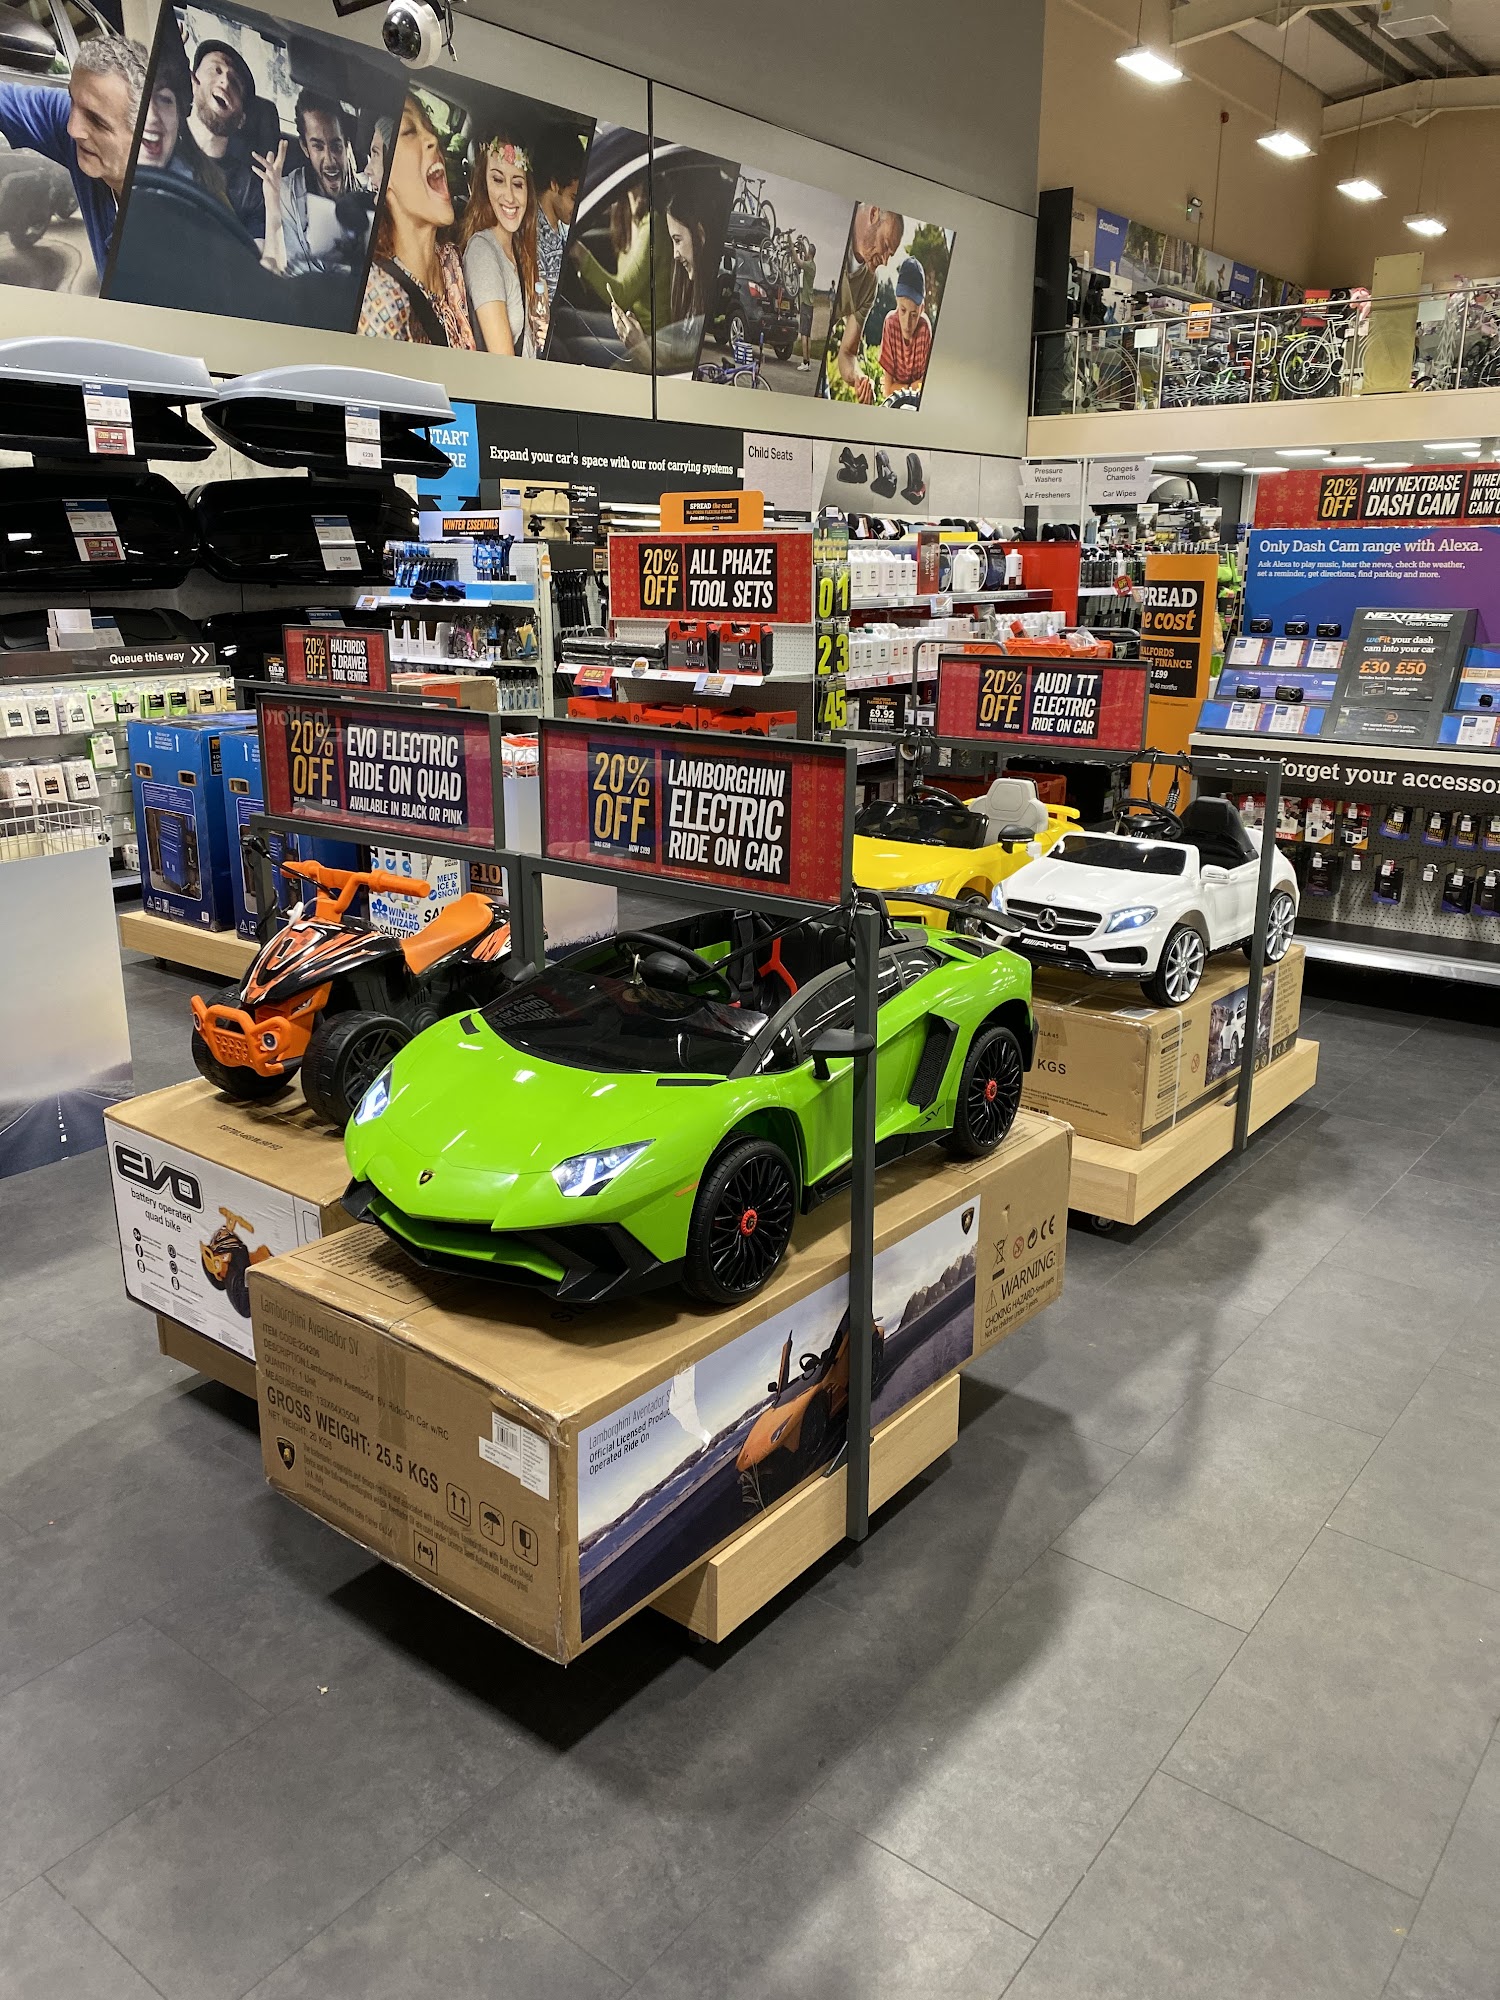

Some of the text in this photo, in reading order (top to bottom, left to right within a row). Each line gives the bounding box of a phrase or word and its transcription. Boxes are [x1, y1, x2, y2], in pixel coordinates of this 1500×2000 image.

[490, 446, 733, 475] Expand your car's space with our roof carrying systems
[748, 445, 793, 461] Child Seats
[1323, 475, 1463, 496] 20% ANY NEXTBASE
[1470, 488, 1483, 500] IN
[1321, 493, 1494, 517] OFF DASH CAM CAM
[444, 519, 498, 530] WINTER ESSENTIALS
[1260, 539, 1482, 554] Only Dash Cam range with Alexa.
[643, 548, 773, 575] 20% ALL PHAZE
[1301, 560, 1316, 569] play
[1432, 561, 1465, 569] weather,
[1274, 570, 1306, 578] reminder,
[1320, 570, 1356, 578] directions,
[1374, 571, 1402, 579] parking
[644, 576, 773, 608] OFF TOOL SETS
[819, 572, 848, 618] 0 1
[1154, 609, 1196, 630] cost
[1364, 612, 1454, 623] NEXTBASE
[305, 638, 365, 655] 20% HALFORDS
[1366, 636, 1391, 644] weFit
[110, 652, 185, 665] Queue this way
[307, 655, 366, 675] OFF 6 DRAWER
[818, 634, 849, 675] 2 3
[1155, 659, 1192, 669] FINANCE
[333, 669, 368, 682] TOOL CENTRE
[1154, 670, 1168, 679] £99
[1359, 661, 1426, 675] £30 £50
[981, 669, 1098, 695] 20% AUDI TT
[870, 709, 894, 718] £9.92
[980, 694, 1096, 723] OFF ELECTRIC
[1031, 718, 1095, 735] RIDE ON CAR
[290, 720, 459, 768] 20% EVO ELECTRIC
[293, 755, 462, 802] OFF RIDE ON QUAD
[594, 752, 785, 798] 20% LAMBORGHINI
[1281, 758, 1340, 782] forget
[1345, 767, 1397, 786] your
[1402, 772, 1500, 794] accesso
[350, 795, 388, 815] AVAILABLE
[390, 800, 400, 816] IN
[401, 802, 427, 820] BLACK
[429, 807, 441, 822] OR
[442, 809, 463, 825] PINK
[594, 788, 785, 843] OFF ELECTRIC
[628, 844, 639, 853] NOW
[668, 830, 708, 863] RIDE
[714, 836, 740, 867] ON
[745, 840, 784, 875] CAR
[437, 872, 458, 884] MELTS
[471, 863, 500, 884] £10
[438, 882, 449, 891] ICE
[438, 888, 459, 899] SNOW
[388, 907, 418, 920] WINTER
[389, 917, 420, 930] WIZARD
[1037, 1058, 1066, 1074] KGS
[116, 1145, 201, 1209] EVO
[131, 1188, 192, 1224] battery operated
[145, 1210, 181, 1232] quad bike
[1001, 1250, 1055, 1300] WARNING:
[260, 1294, 345, 1351] Lamborghini Aventador
[589, 1396, 664, 1450] Lamborghini Aventador
[267, 1384, 310, 1423] GROSS
[315, 1410, 369, 1456] WEIGHT:
[376, 1442, 402, 1474] 25.5
[408, 1460, 438, 1494] KGS
[589, 1408, 670, 1463] Official Licensed Produc
[589, 1432, 650, 1475] Operated Ride On
